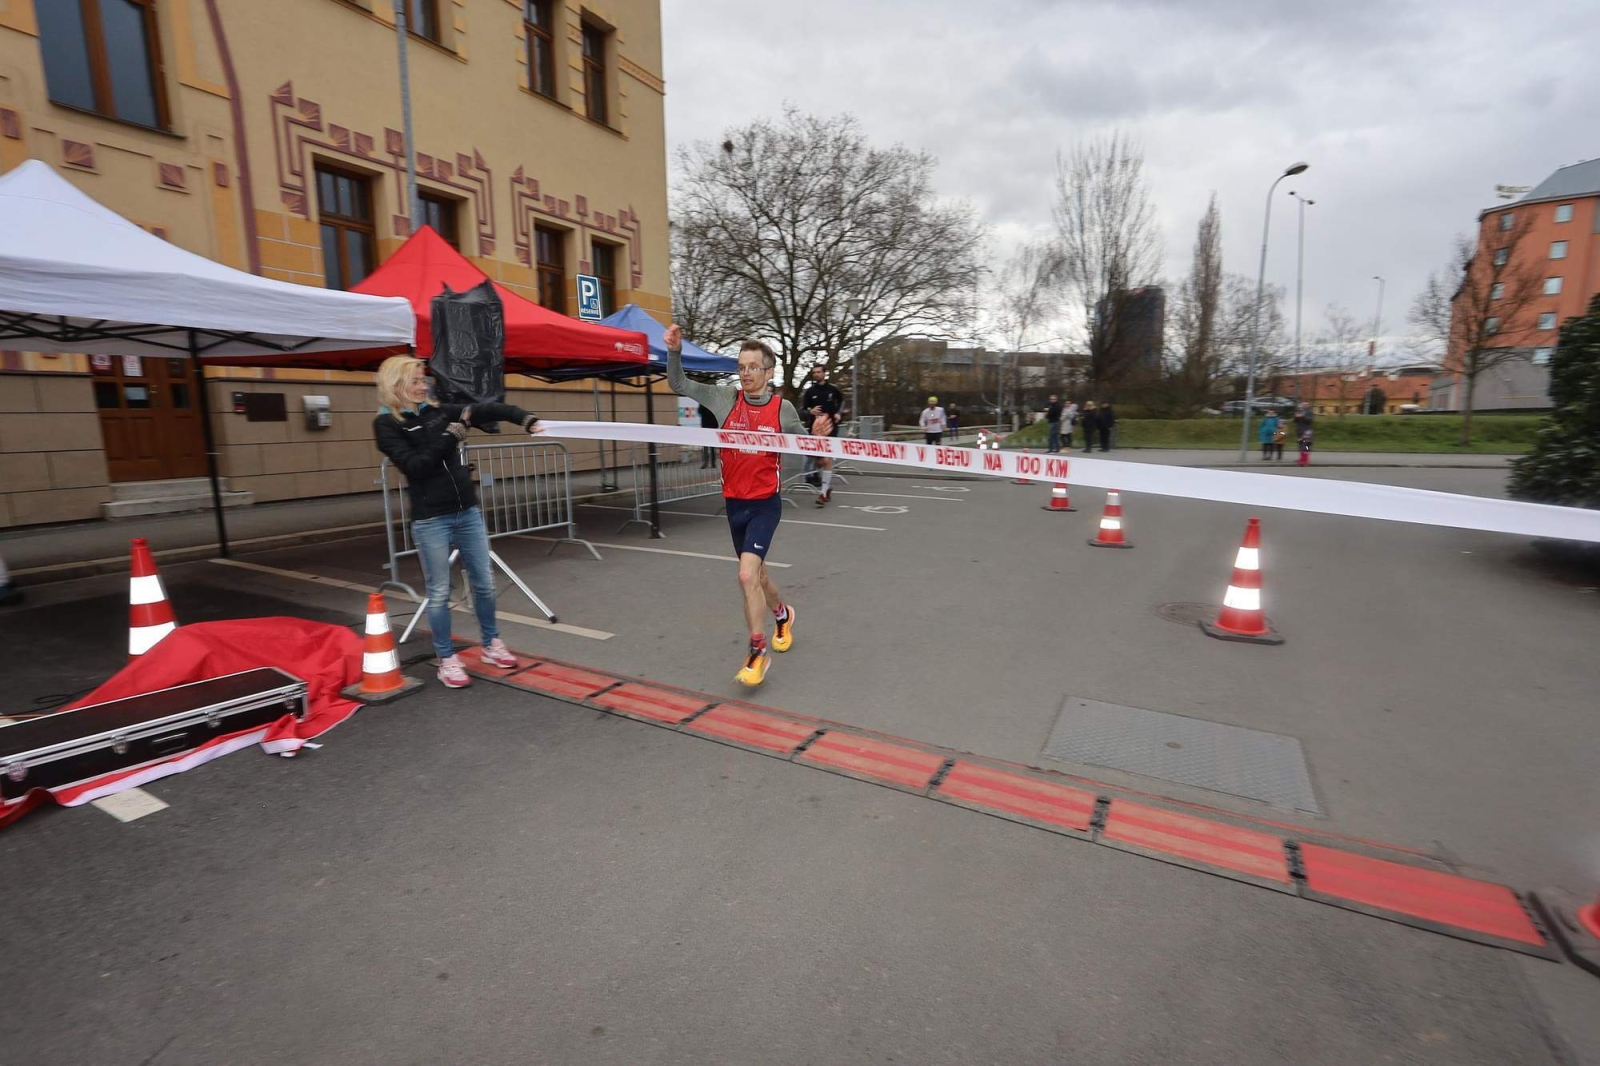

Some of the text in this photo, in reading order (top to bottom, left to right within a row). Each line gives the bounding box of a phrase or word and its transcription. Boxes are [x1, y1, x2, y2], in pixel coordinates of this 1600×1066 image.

[581, 280, 594, 305] P
[917, 446, 926, 462] V
[983, 453, 1004, 471] NA
[1015, 455, 1041, 475] 100
[1045, 458, 1069, 479] KM
